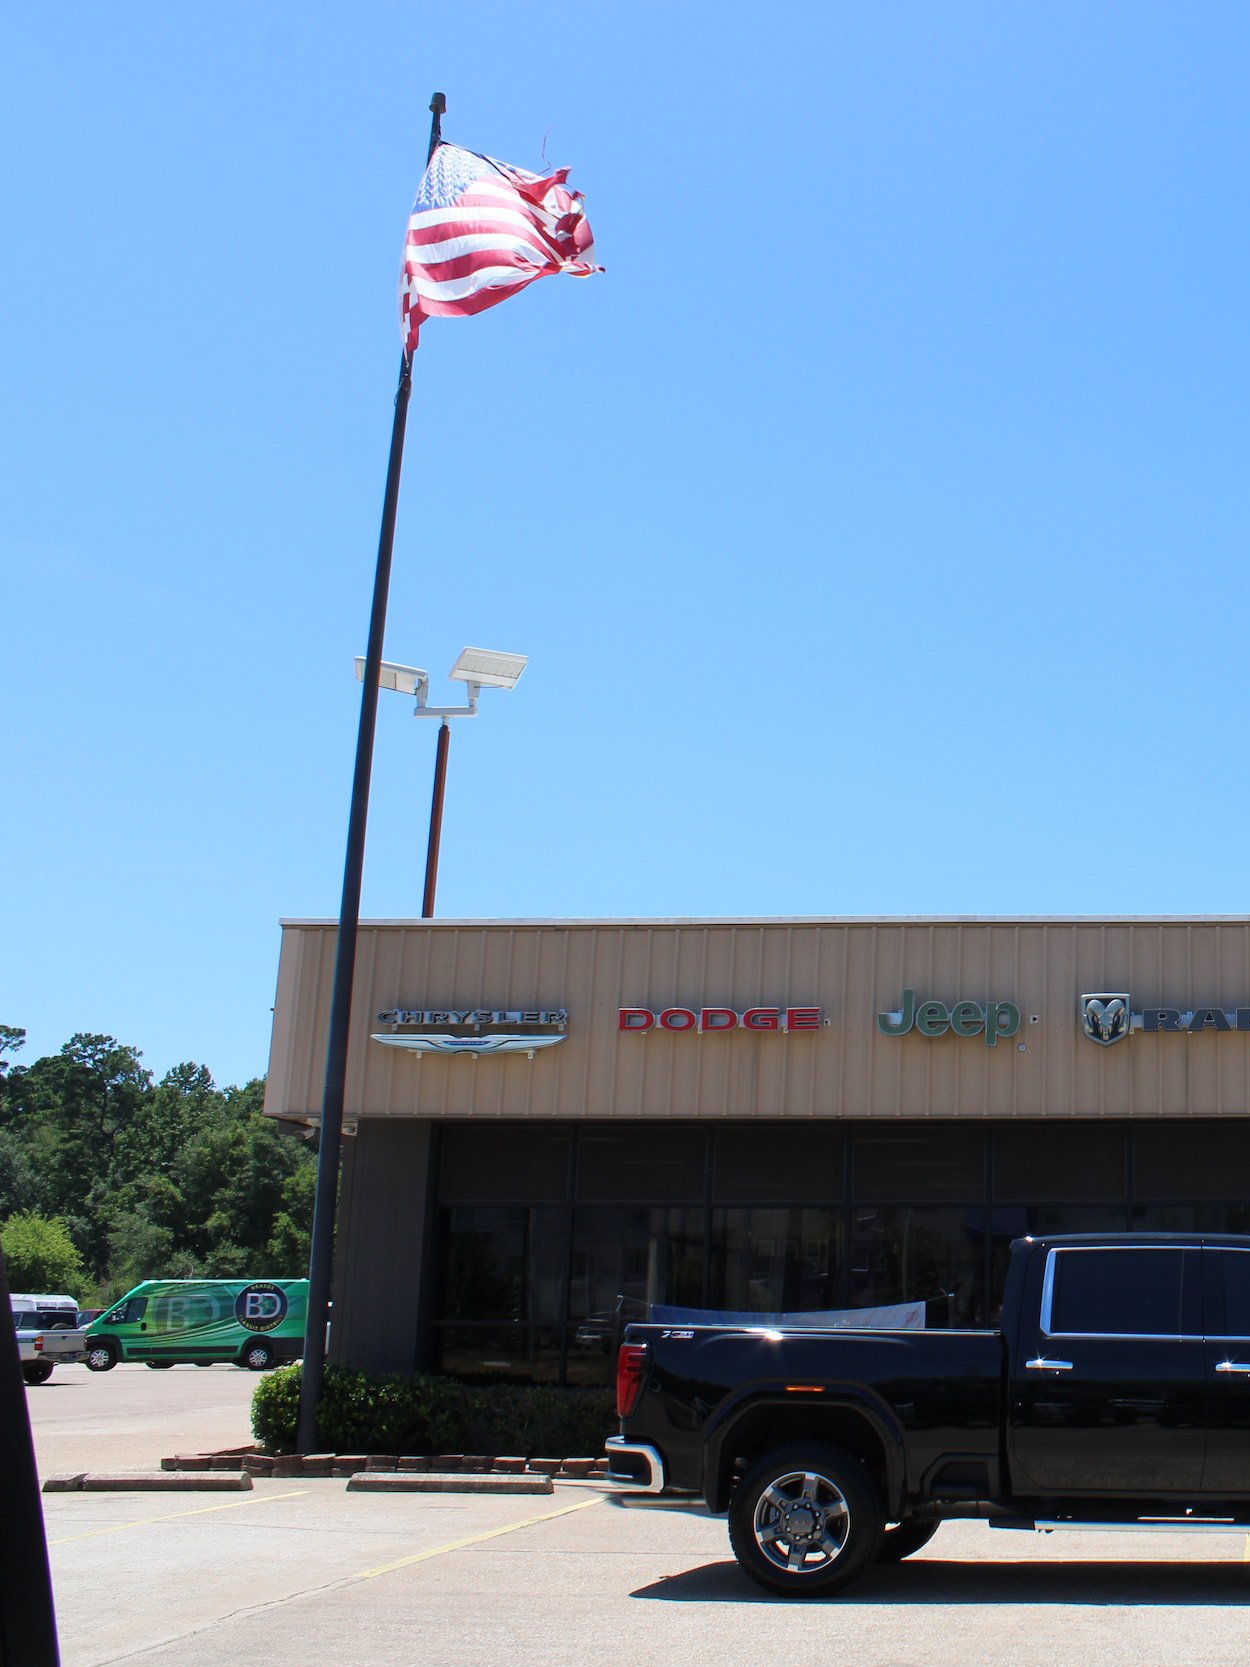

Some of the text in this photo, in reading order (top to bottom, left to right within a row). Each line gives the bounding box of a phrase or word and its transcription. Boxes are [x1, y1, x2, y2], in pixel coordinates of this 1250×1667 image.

[377, 1008, 568, 1025] CHRYSLER
[618, 1006, 821, 1031] DODGE
[877, 988, 1021, 1047] Jeep
[245, 1292, 281, 1319] BD
